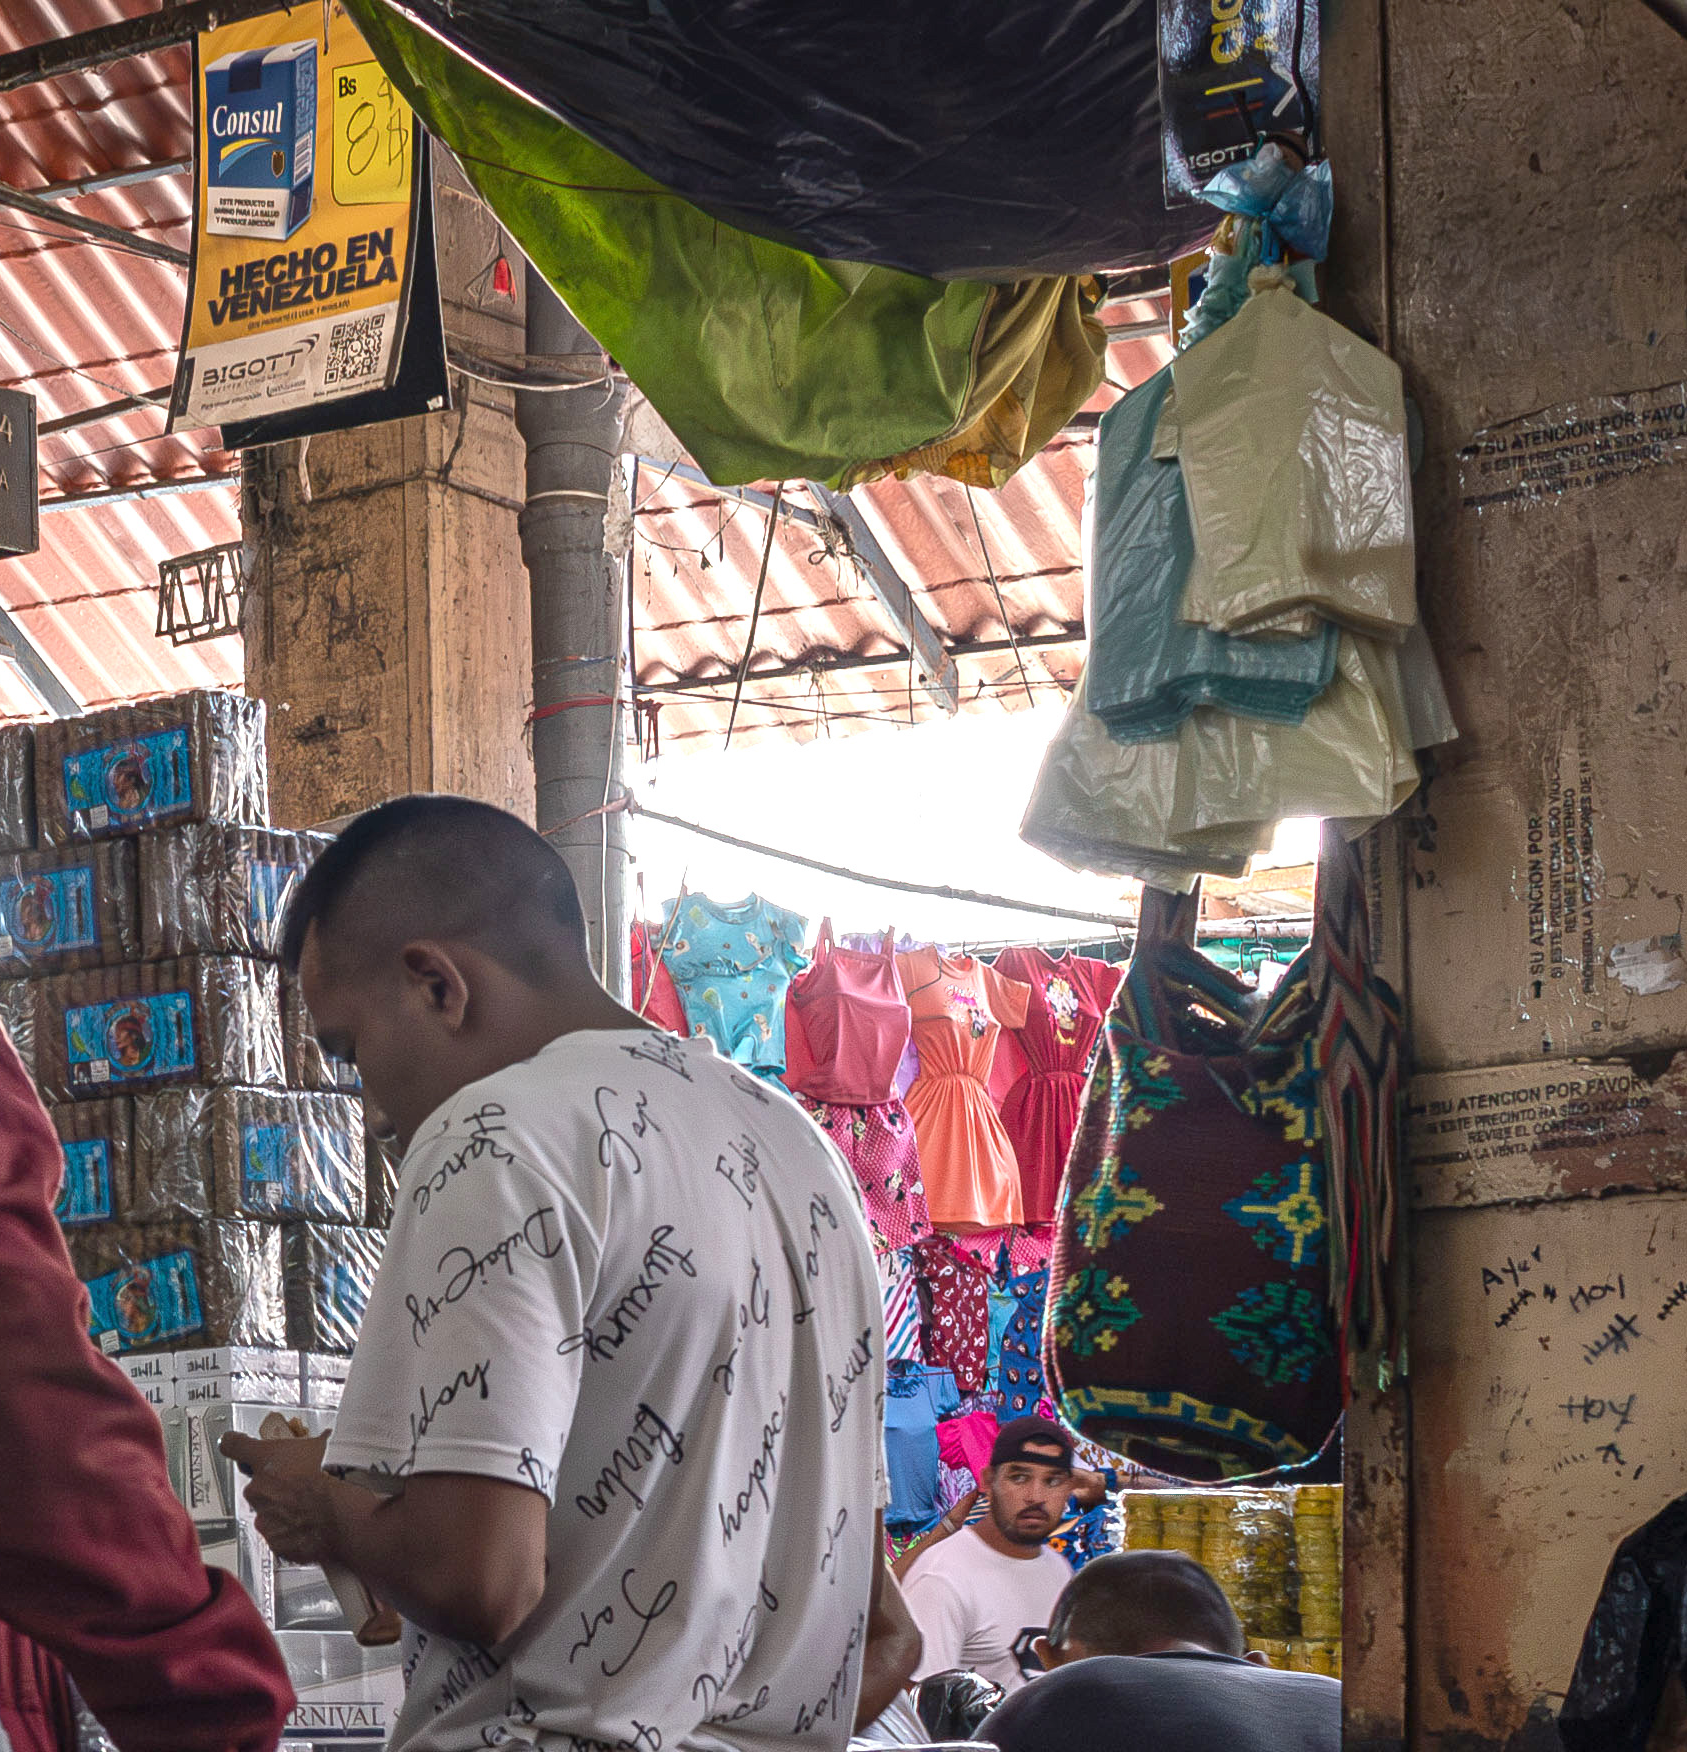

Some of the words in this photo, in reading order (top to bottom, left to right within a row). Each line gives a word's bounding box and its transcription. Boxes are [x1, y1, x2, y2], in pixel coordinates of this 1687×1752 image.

[337, 76, 357, 97] Bs
[211, 101, 283, 138] Consul
[1185, 142, 1255, 169] IGOTT
[219, 242, 338, 298] HECHO
[345, 227, 395, 267] EN
[208, 255, 399, 328] VENEZUELA
[202, 348, 304, 388] BIGOTT
[1511, 420, 1595, 450] ATENCION
[1643, 403, 1687, 424] FAVO
[1528, 816, 1544, 855] POR
[1528, 859, 1545, 949] ATENCION
[1529, 952, 1544, 976] SU
[1457, 1086, 1541, 1112] ATENCION
[1545, 1080, 1582, 1100] POR
[287, 1705, 386, 1735] RNIVAL
